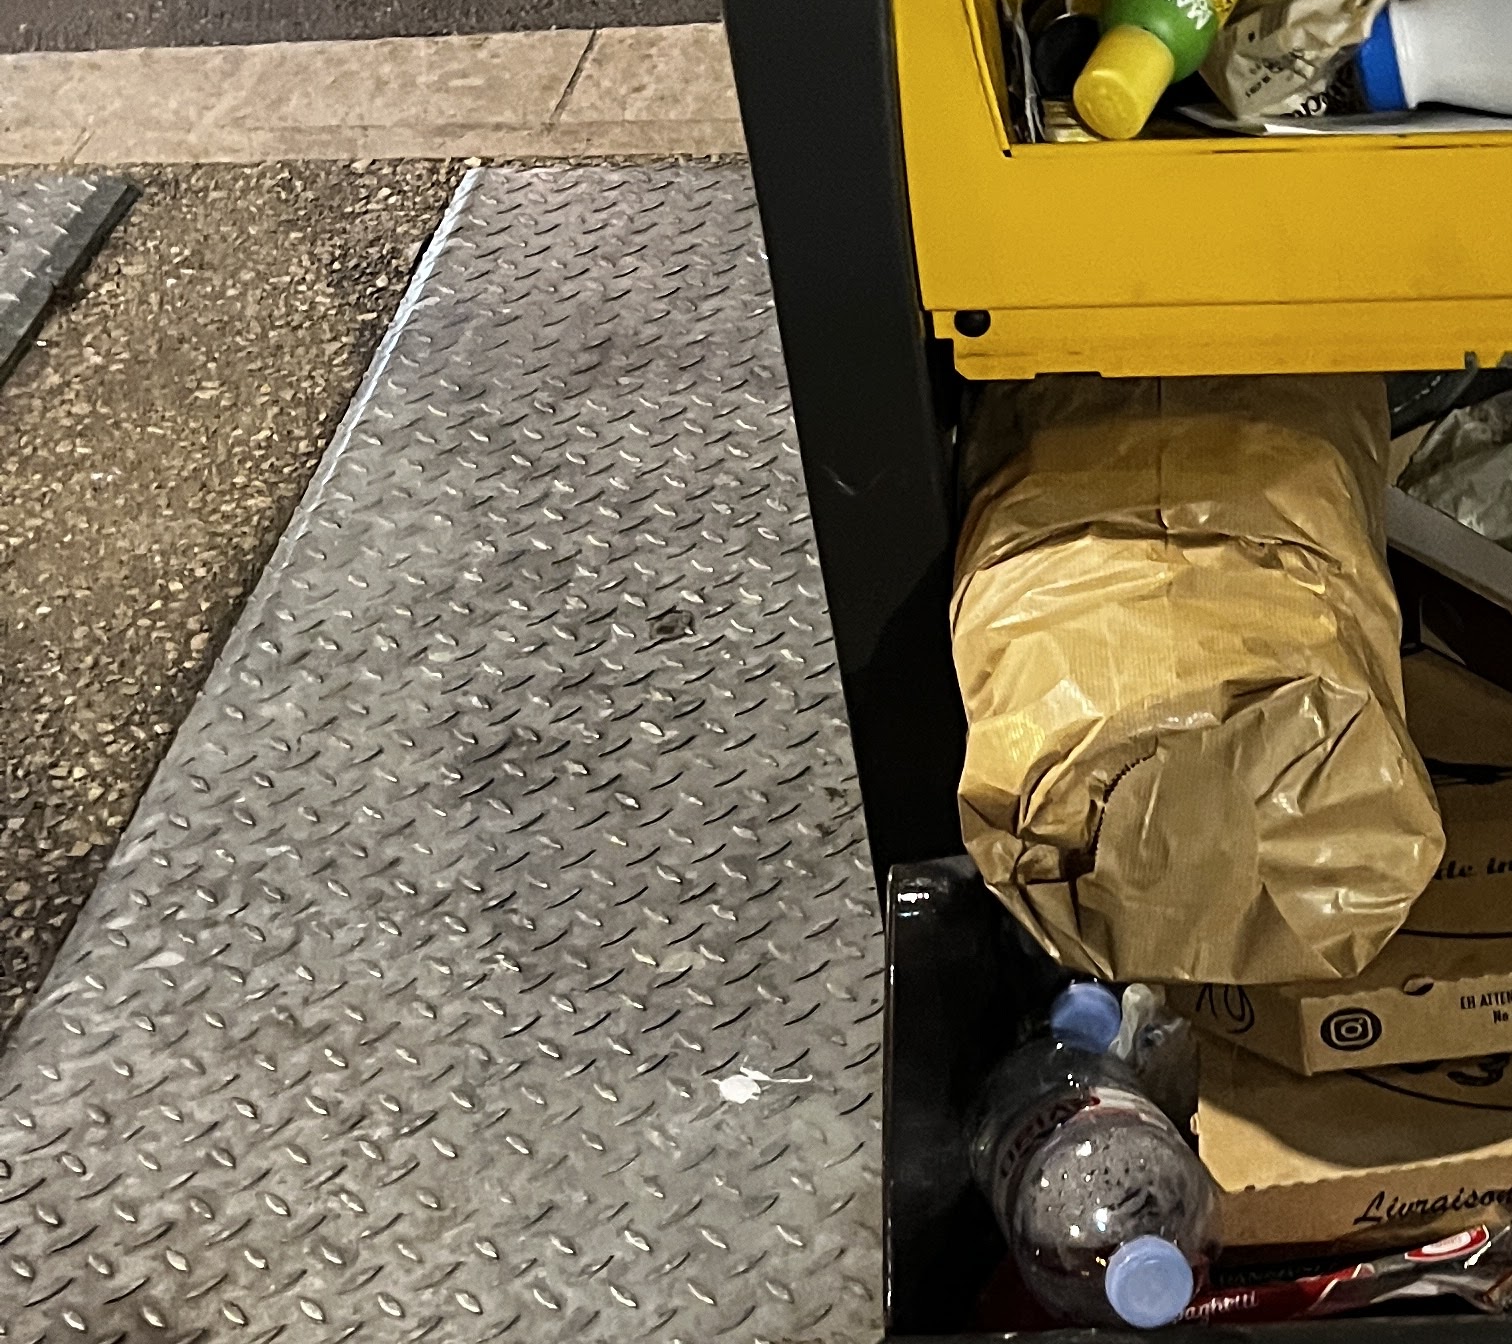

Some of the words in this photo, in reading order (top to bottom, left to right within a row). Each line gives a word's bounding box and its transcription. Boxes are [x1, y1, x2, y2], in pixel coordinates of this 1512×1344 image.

[1433, 859, 1475, 882] de
[1459, 995, 1477, 1010] EH
[1492, 1008, 1509, 1024] Ne
